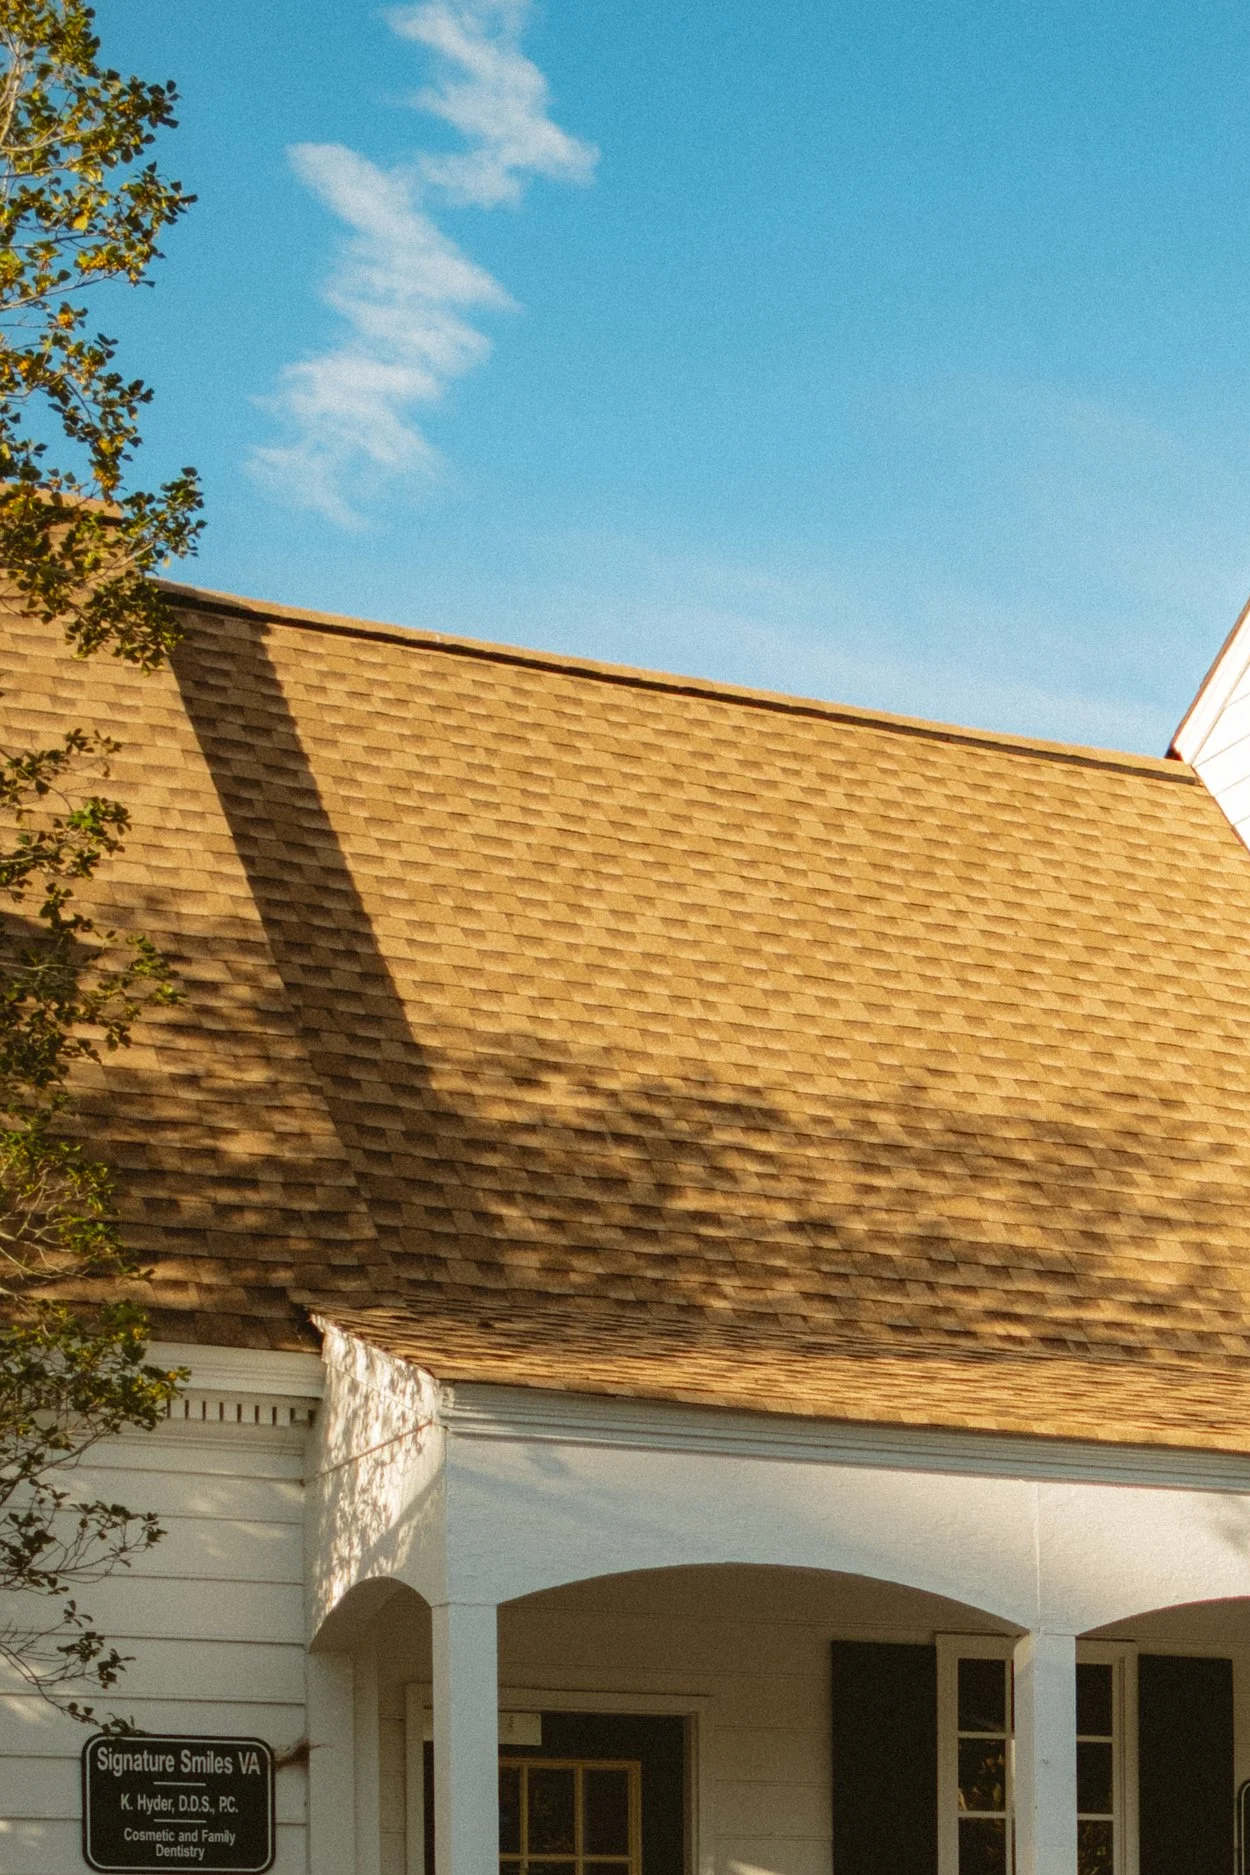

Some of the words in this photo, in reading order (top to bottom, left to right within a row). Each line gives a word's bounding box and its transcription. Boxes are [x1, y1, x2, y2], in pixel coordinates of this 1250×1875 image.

[97, 1746, 175, 1778] Signature
[180, 1749, 234, 1775] Smiles
[238, 1751, 262, 1776] VA
[120, 1792, 133, 1811] K.
[137, 1794, 176, 1815] Hyder,
[179, 1795, 215, 1815] D.D.S.,
[219, 1796, 239, 1814] P.C.
[123, 1827, 175, 1842] Cosmetic
[178, 1829, 198, 1843] and
[201, 1829, 237, 1847] Family
[155, 1843, 206, 1861] Dentistry
